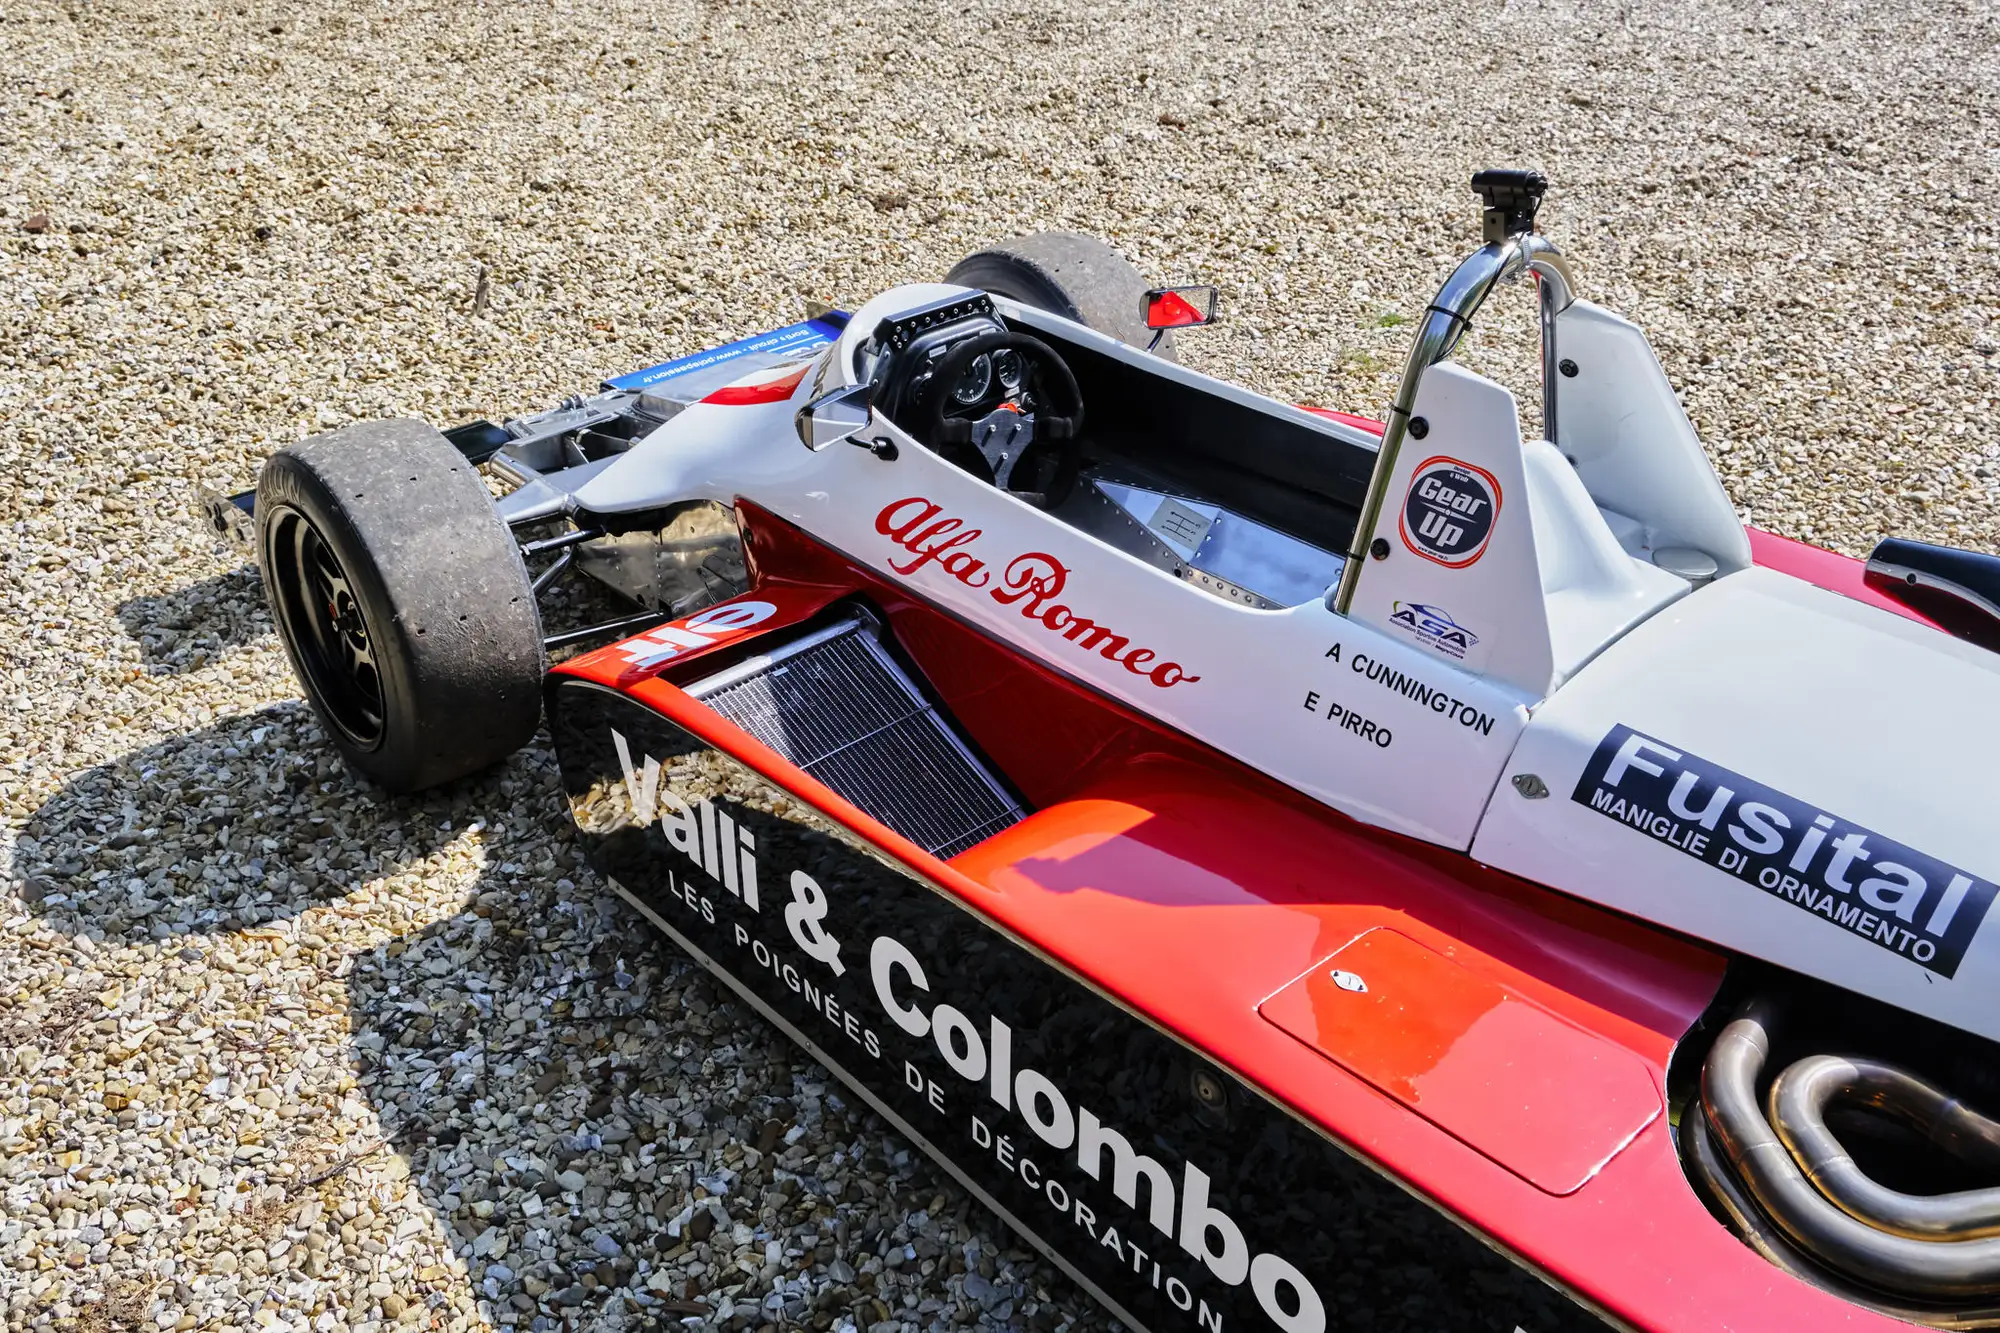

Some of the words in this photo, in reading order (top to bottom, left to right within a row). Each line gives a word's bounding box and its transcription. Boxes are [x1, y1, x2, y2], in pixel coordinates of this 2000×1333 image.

[1418, 477, 1487, 516] Gear
[1418, 511, 1464, 547] Up
[875, 496, 990, 588] Alfa
[990, 552, 1201, 688] Romeo
[1391, 609, 1468, 648] ASA
[1304, 691, 1320, 712] E
[1327, 703, 1392, 748] PIRRO
[1325, 643, 1341, 663] A
[1352, 654, 1495, 736] CUNNINGTON
[1590, 788, 1710, 857] MANIGLIE
[1718, 847, 1747, 875] DI
[1758, 866, 1936, 963] ORNAMENTO
[1602, 733, 1973, 938] Fusital
[610, 728, 760, 914] Valli
[784, 869, 846, 978] &
[870, 935, 1327, 1333] Colombo
[669, 869, 716, 925] LES
[735, 923, 881, 1059] POIGNÉES
[904, 1061, 946, 1115] DE
[972, 1116, 1223, 1333] DÉCORATION
